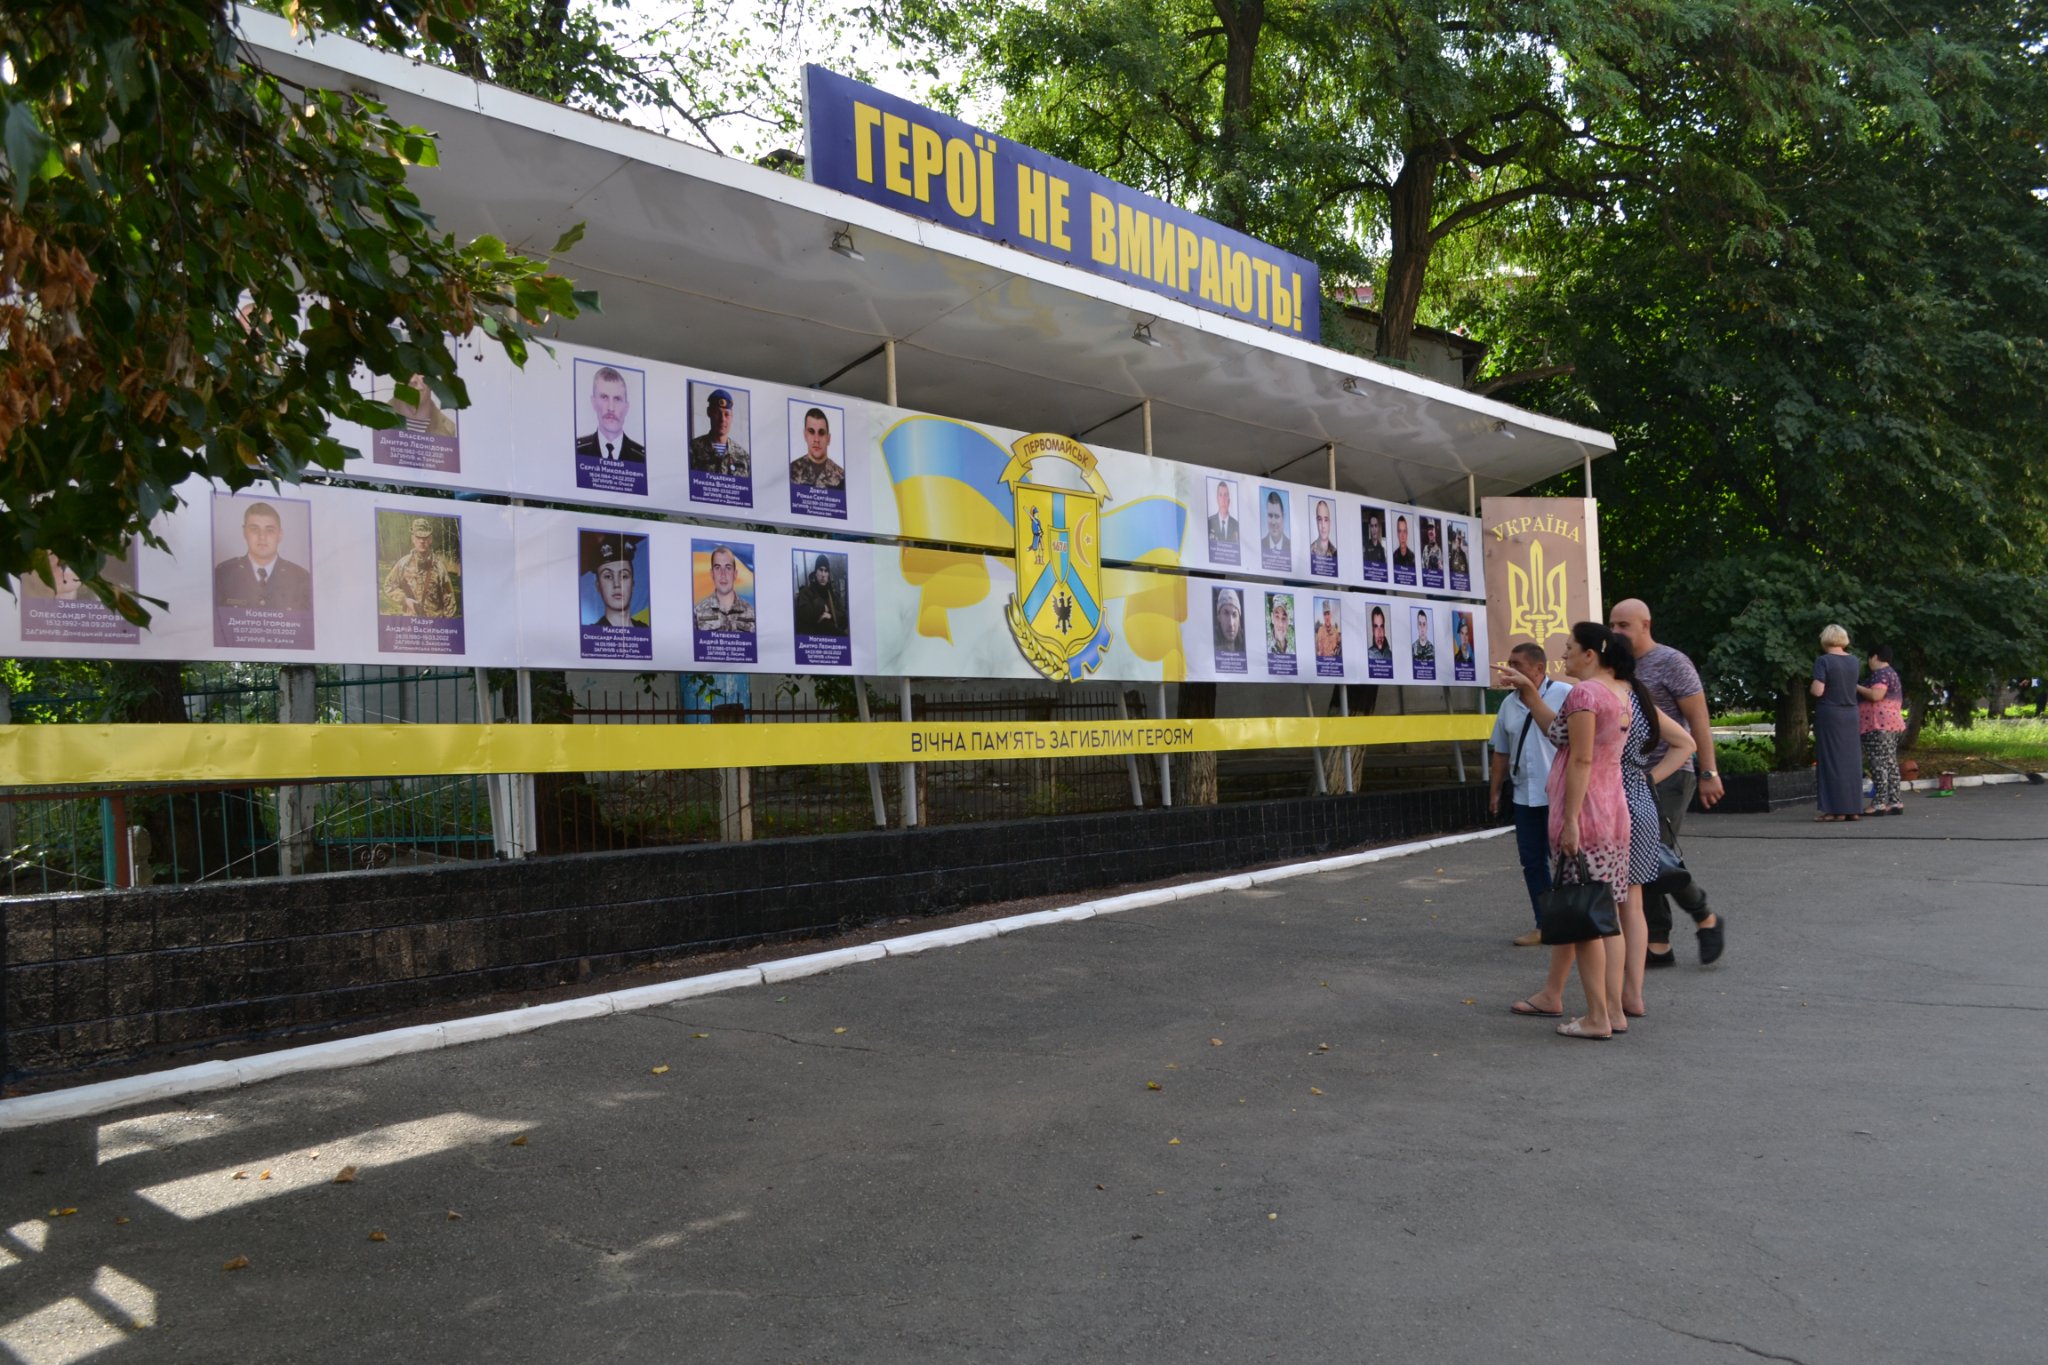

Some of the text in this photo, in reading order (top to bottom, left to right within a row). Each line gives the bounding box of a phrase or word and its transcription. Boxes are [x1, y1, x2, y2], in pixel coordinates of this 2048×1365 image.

[853, 100, 1303, 331] ГЕРОЇ НЕ ВМИРАЮТЬ!
[1023, 438, 1088, 468] ПЕРВОМАЙСЬК
[1490, 513, 1580, 543] УКРАЇНА
[911, 727, 1193, 752] ВІЧНА ПАМ'ЯТЬ ЗАГИБЛИМ ГЕРОЯМ
